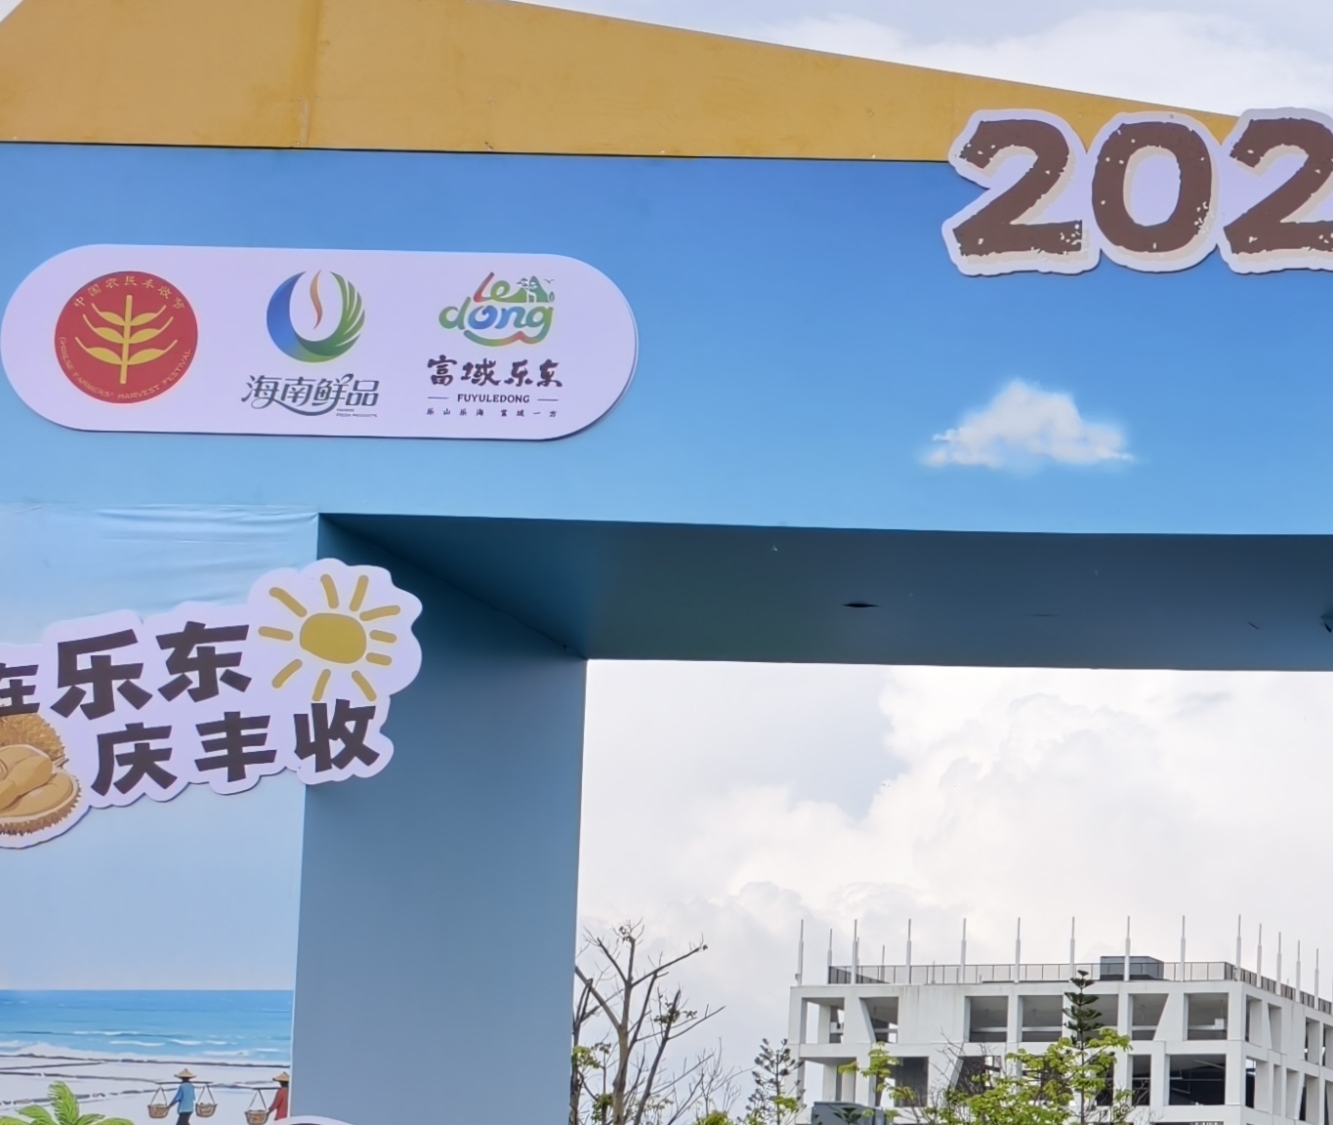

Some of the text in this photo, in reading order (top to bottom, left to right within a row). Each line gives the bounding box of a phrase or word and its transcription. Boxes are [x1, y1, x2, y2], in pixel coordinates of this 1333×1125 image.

[438, 296, 555, 347] dong
[427, 354, 563, 387] 富域乐东
[241, 373, 380, 417] 海南鲜品
[457, 393, 530, 404] FUYULEDONG
[91, 698, 381, 796] 庆丰收
